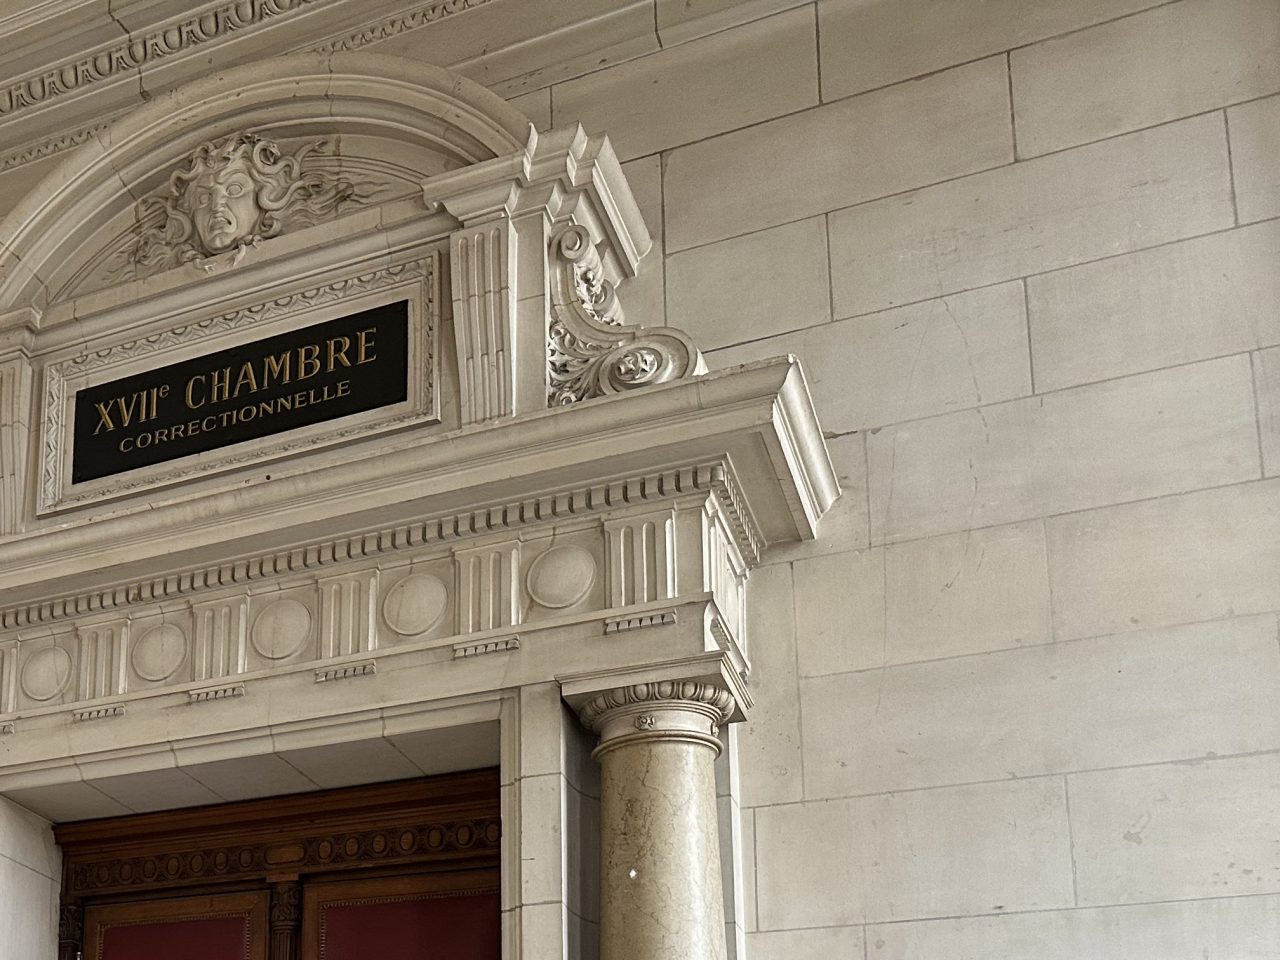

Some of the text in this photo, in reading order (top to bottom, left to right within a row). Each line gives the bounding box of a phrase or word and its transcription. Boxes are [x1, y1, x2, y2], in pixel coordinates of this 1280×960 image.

[91, 327, 378, 436] XVIIe CHAMBRE
[120, 379, 351, 453] CORRECTIONNELLE
